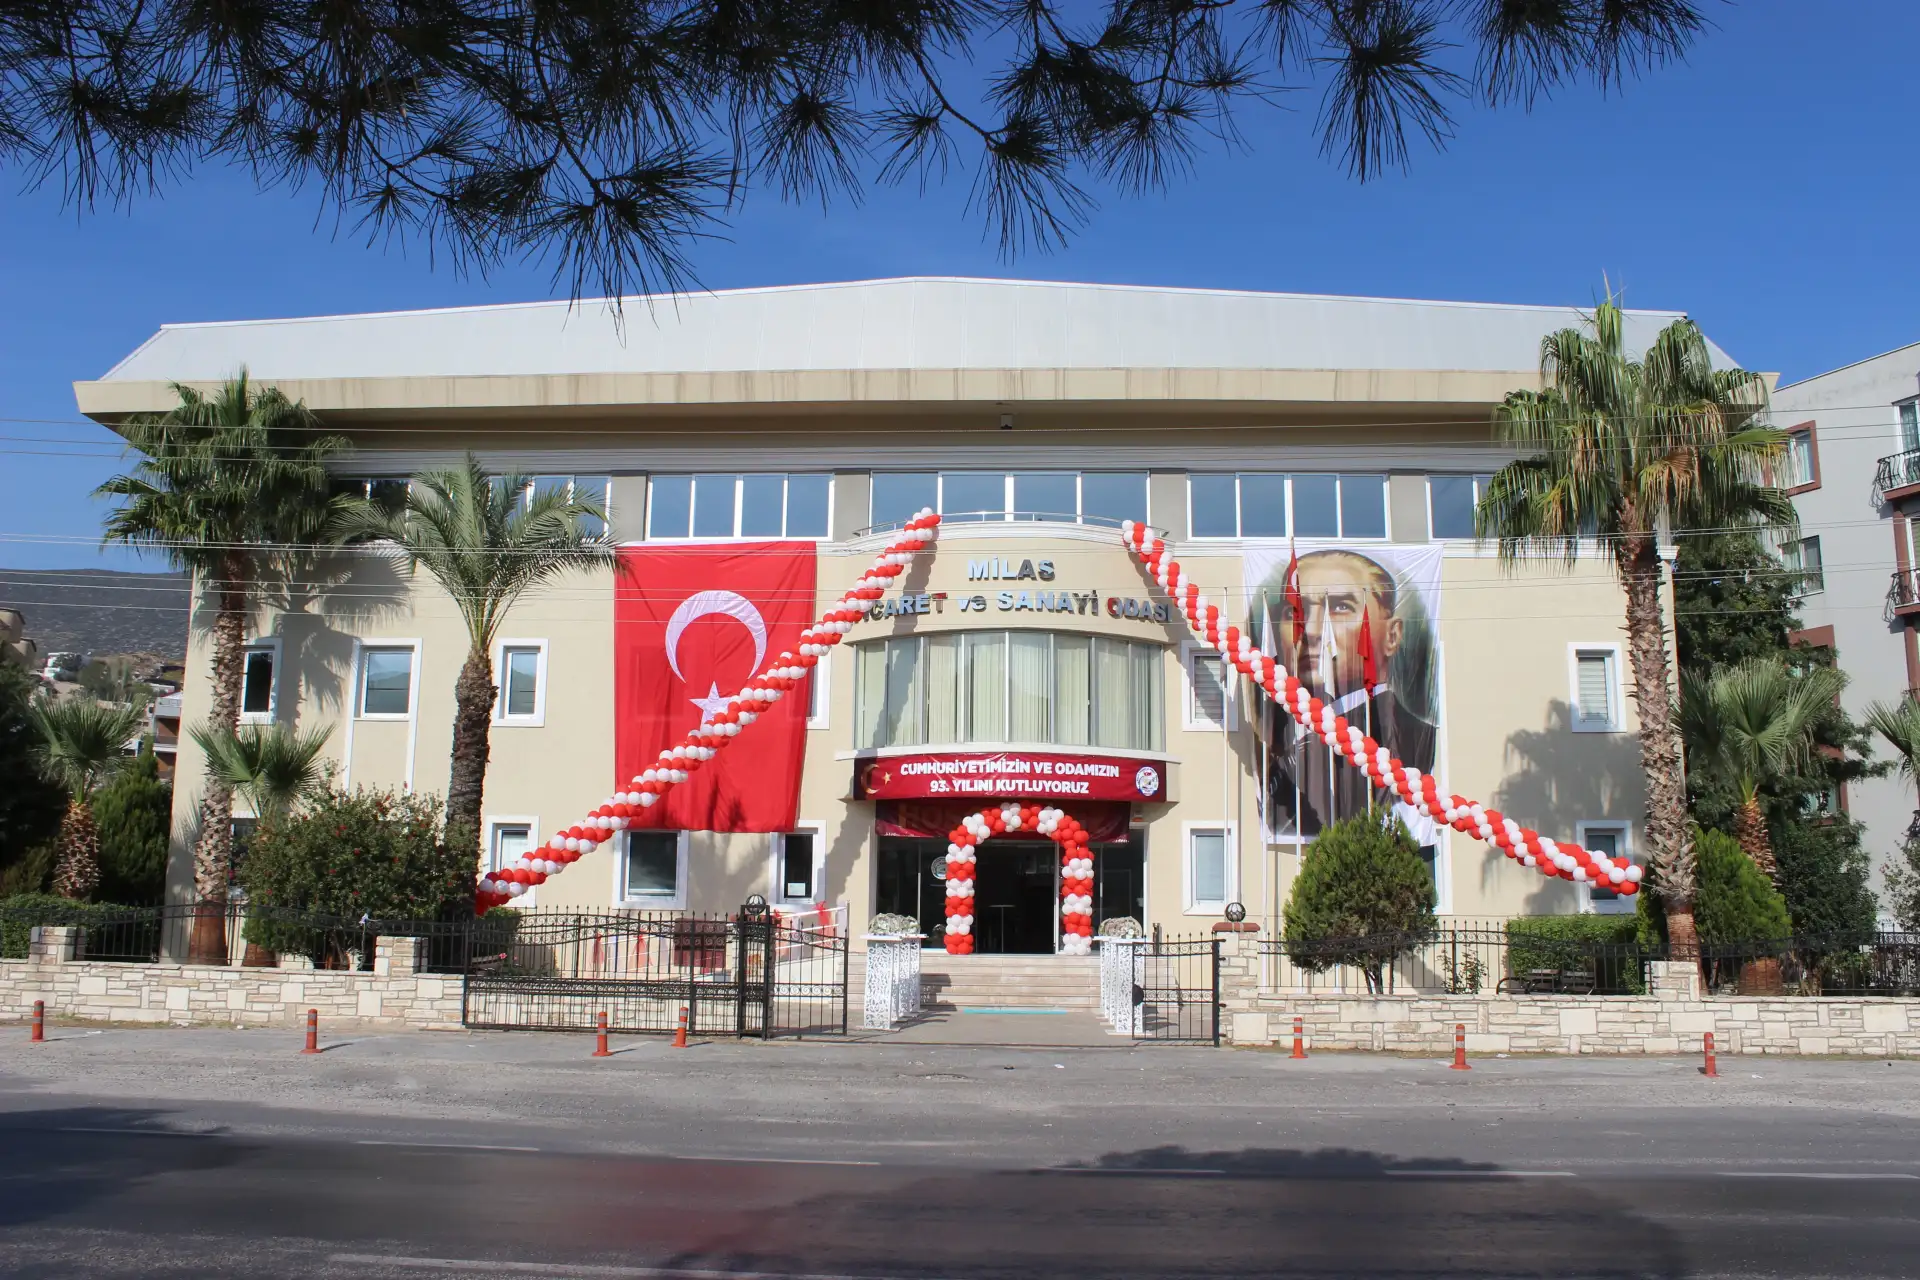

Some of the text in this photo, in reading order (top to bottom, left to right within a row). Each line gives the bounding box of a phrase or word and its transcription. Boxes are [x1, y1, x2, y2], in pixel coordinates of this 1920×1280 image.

[967, 556, 1055, 581] MİLAS
[863, 590, 1172, 623] CARET ve SANAYİ ODASI
[900, 759, 1119, 777] CUMHURİYETİMİZİN VE ODAMIZIN
[930, 779, 1089, 793] 93. YILINI KUTLUYORUZ
